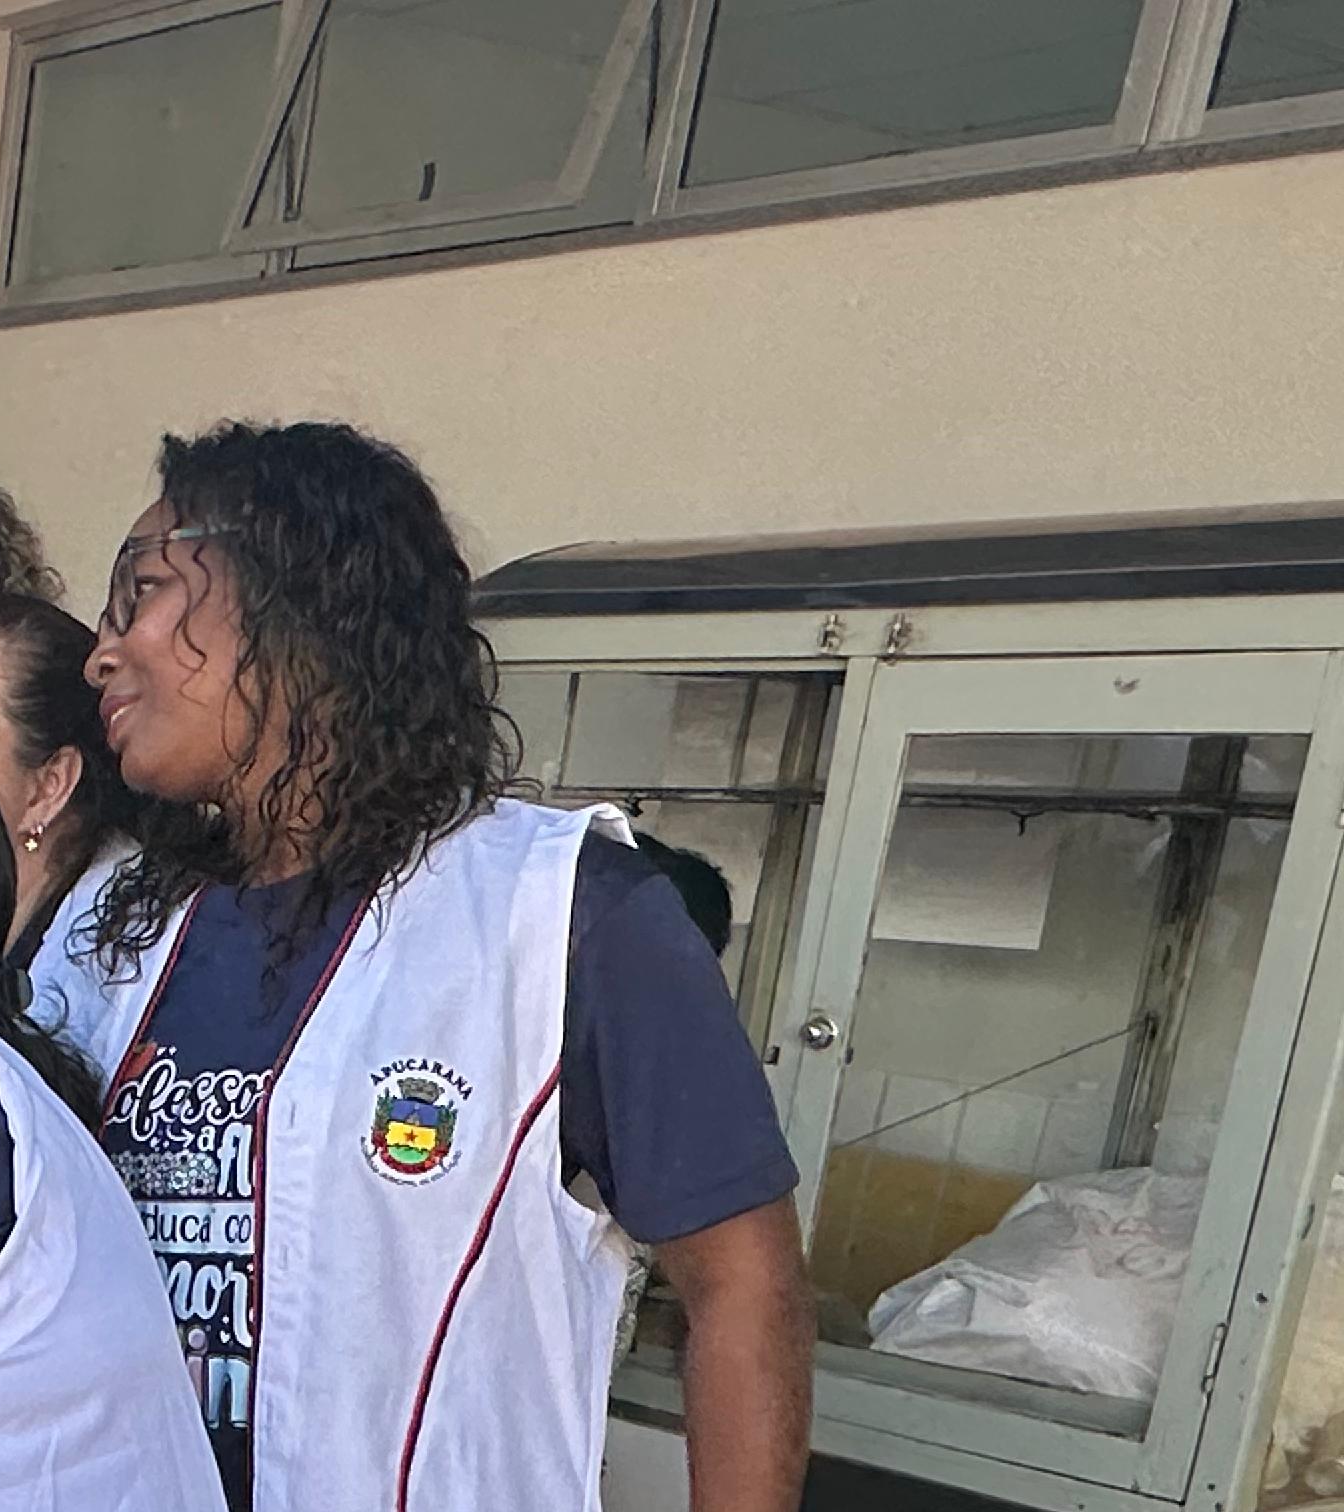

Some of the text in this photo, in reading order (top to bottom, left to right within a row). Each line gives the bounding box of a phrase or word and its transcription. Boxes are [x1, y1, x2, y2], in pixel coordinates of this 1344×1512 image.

[104, 1057, 275, 1143] ofesso
[369, 1057, 474, 1101] APUCARANA
[197, 1124, 216, 1152] a
[141, 1203, 253, 1244] duca co
